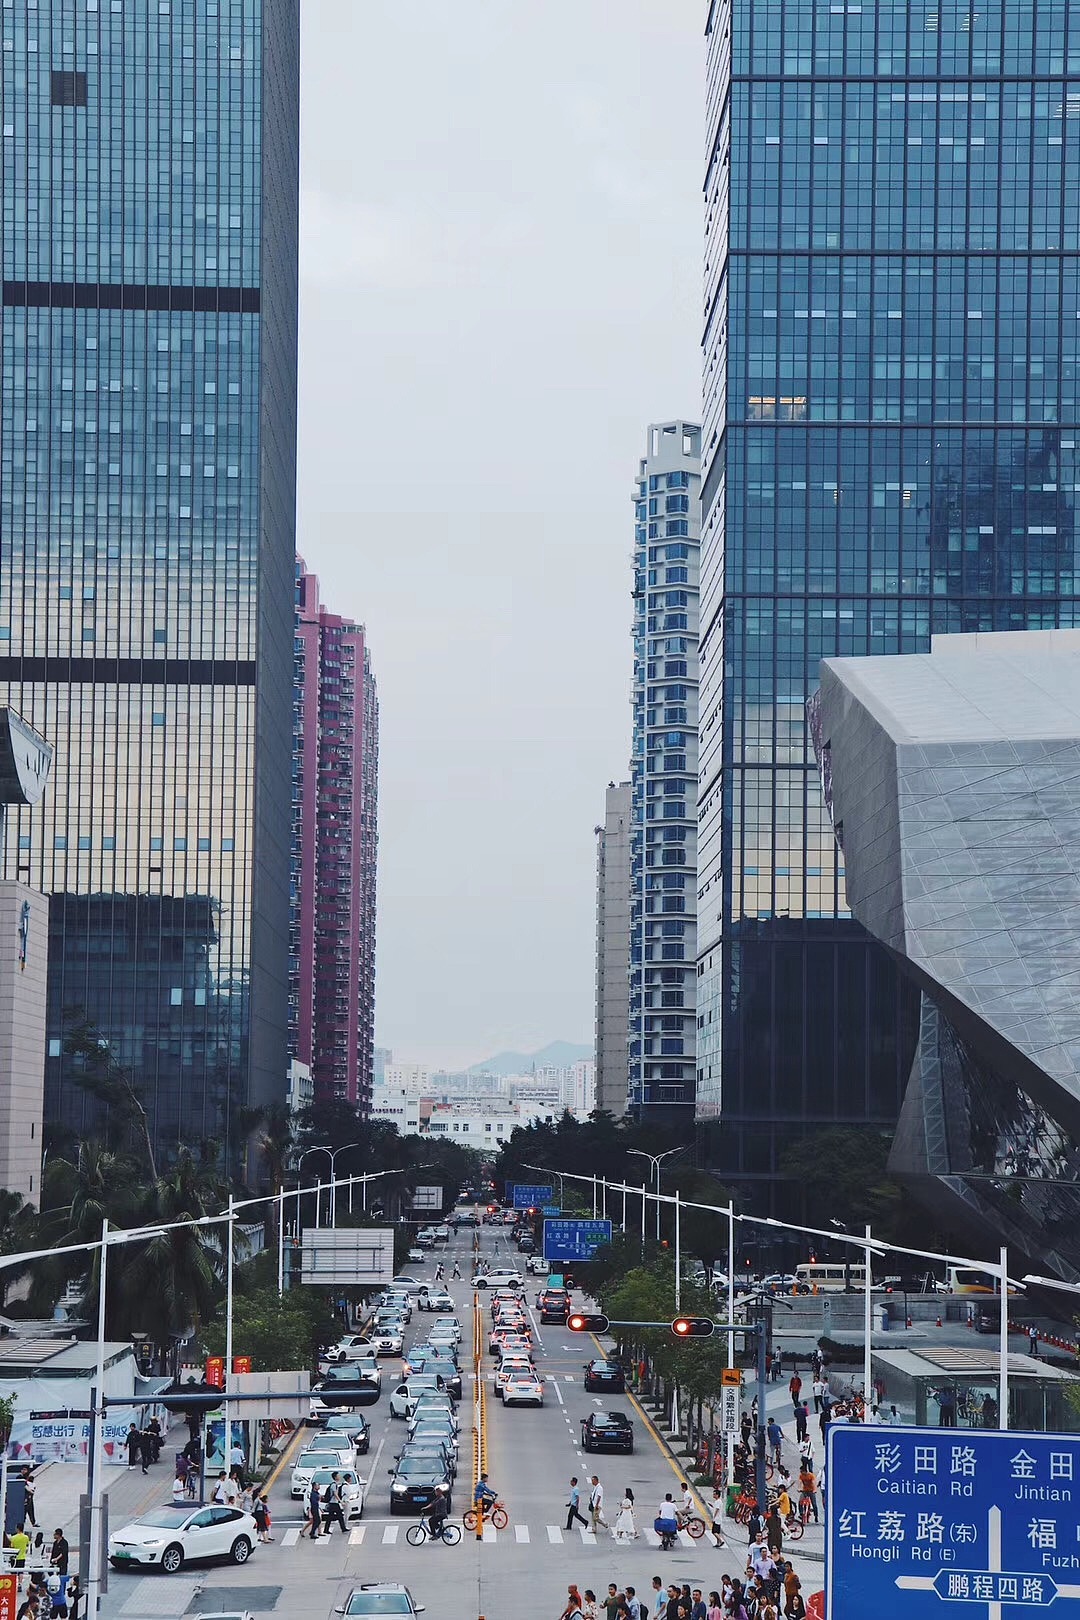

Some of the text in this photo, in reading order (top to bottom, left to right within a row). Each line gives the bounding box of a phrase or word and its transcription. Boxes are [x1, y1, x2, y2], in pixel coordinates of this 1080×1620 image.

[823, 1301, 830, 1309] P
[726, 1388, 735, 1429] 交通繁忙路段
[32, 1424, 75, 1439] 智慧出行
[874, 1442, 977, 1477] 彩田路
[1009, 1448, 1073, 1481] 金田
[877, 1478, 973, 1497] Caitian Rd
[1014, 1484, 1071, 1502] Jintian
[1027, 1517, 1080, 1550] 福
[851, 1544, 956, 1562] Hongli Rd (E)
[1042, 1553, 1080, 1568] Fuzh
[948, 1573, 1044, 1602] 鹏程四路
